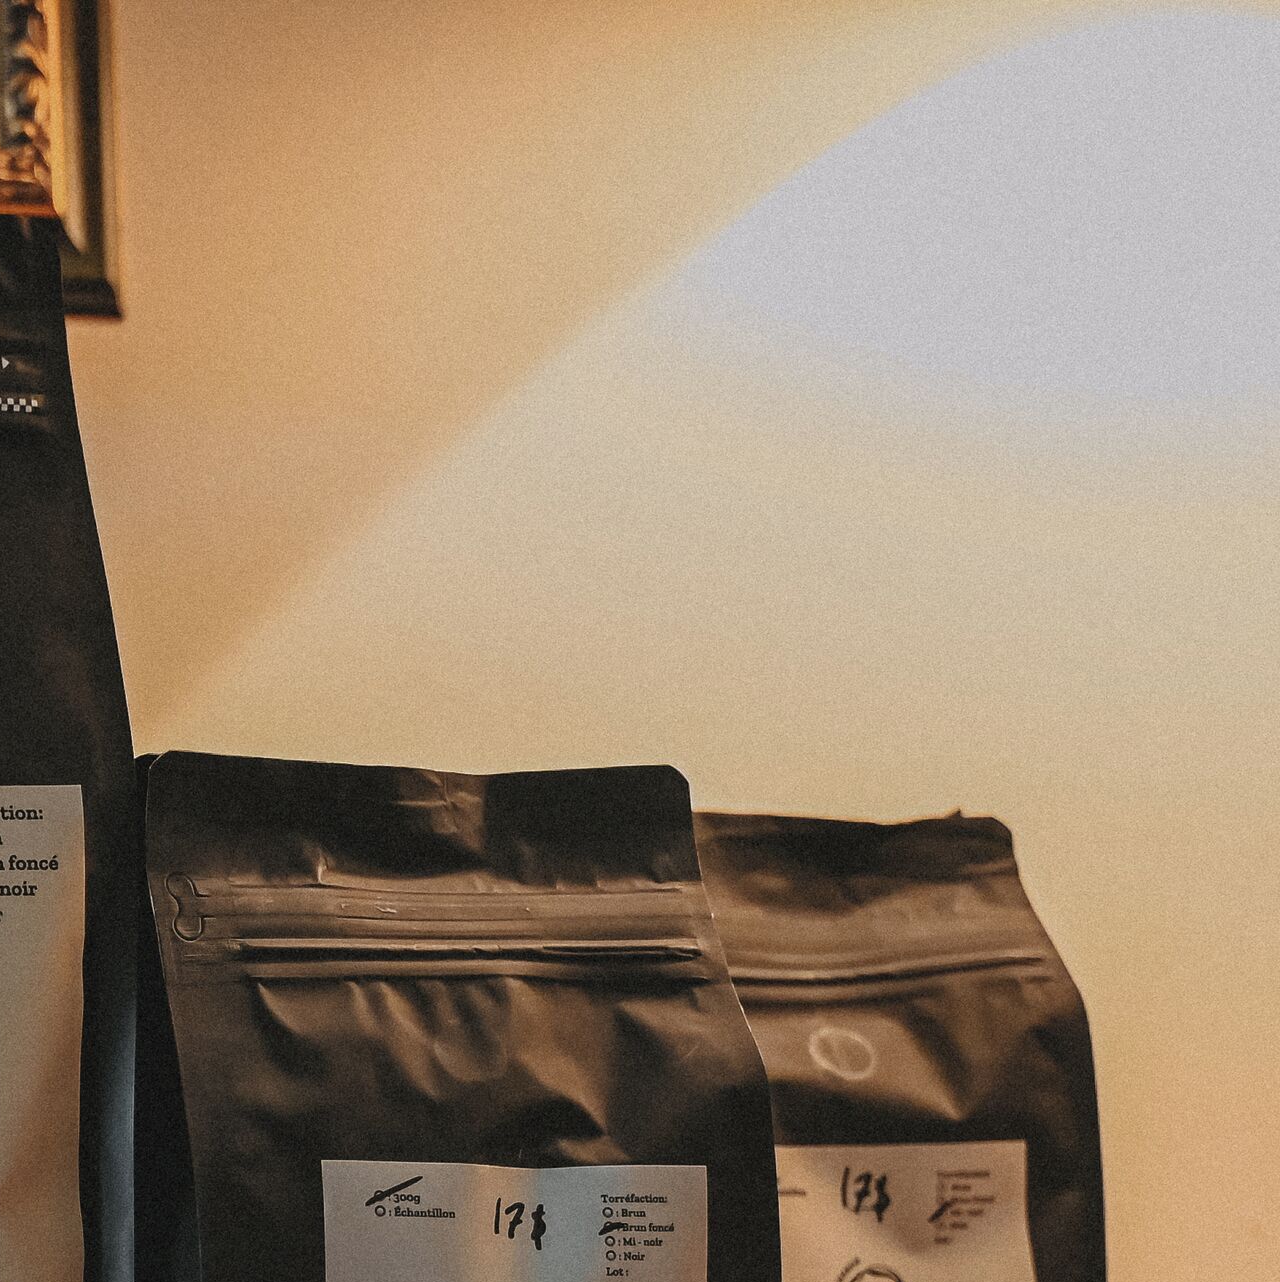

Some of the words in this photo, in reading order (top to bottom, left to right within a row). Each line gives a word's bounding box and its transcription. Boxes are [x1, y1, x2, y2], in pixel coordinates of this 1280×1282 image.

[8, 854, 59, 871] foncé
[0, 880, 38, 897] noir
[393, 1193, 421, 1205] 300g
[600, 1193, 668, 1204] Torréfaction:
[394, 1205, 456, 1219] Échantillon
[621, 1208, 646, 1218] Brun
[493, 1197, 547, 1251] 17$
[648, 1222, 675, 1232] foncé
[643, 1237, 664, 1247] noir
[623, 1251, 646, 1261] Noir
